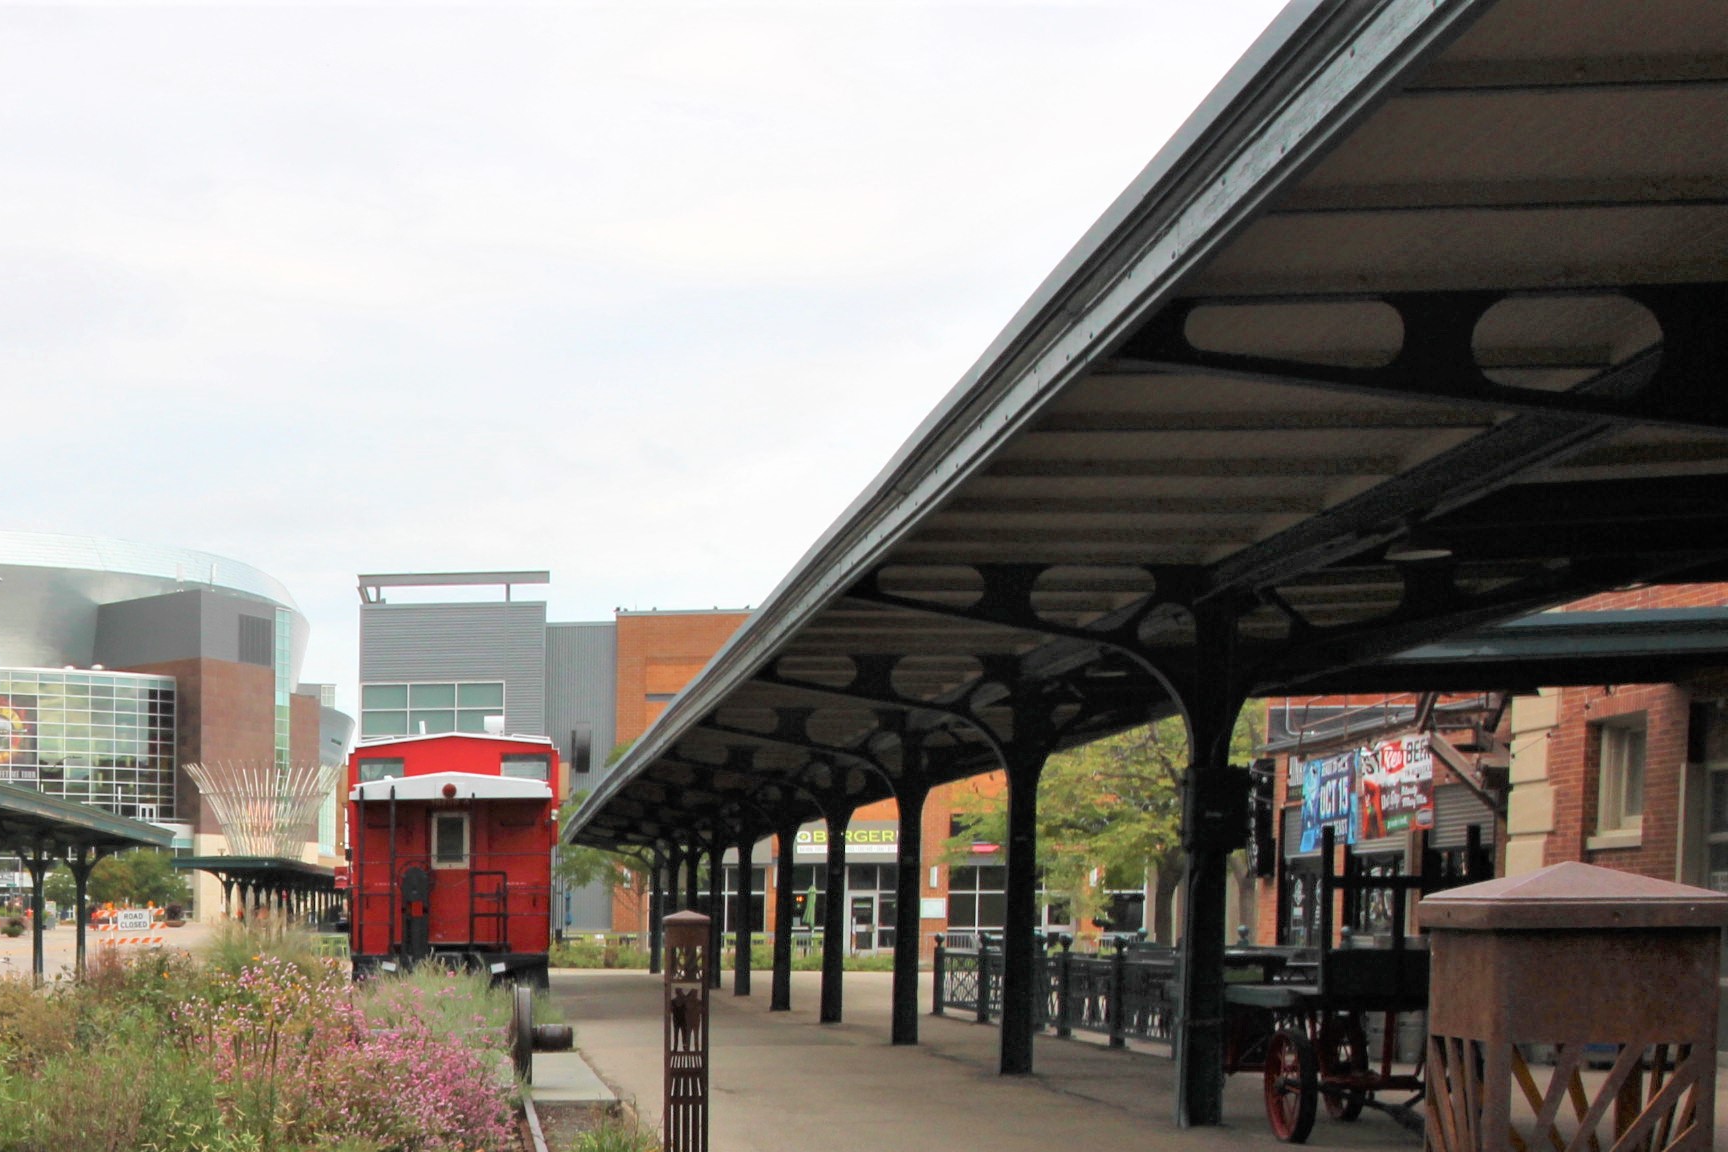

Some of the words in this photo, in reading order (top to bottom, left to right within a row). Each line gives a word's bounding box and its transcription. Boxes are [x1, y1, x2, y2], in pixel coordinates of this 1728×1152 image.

[1319, 779, 1337, 819] OCT
[1338, 776, 1349, 815] 15
[813, 830, 894, 843] BRGER
[120, 921, 148, 929] CLOSED
